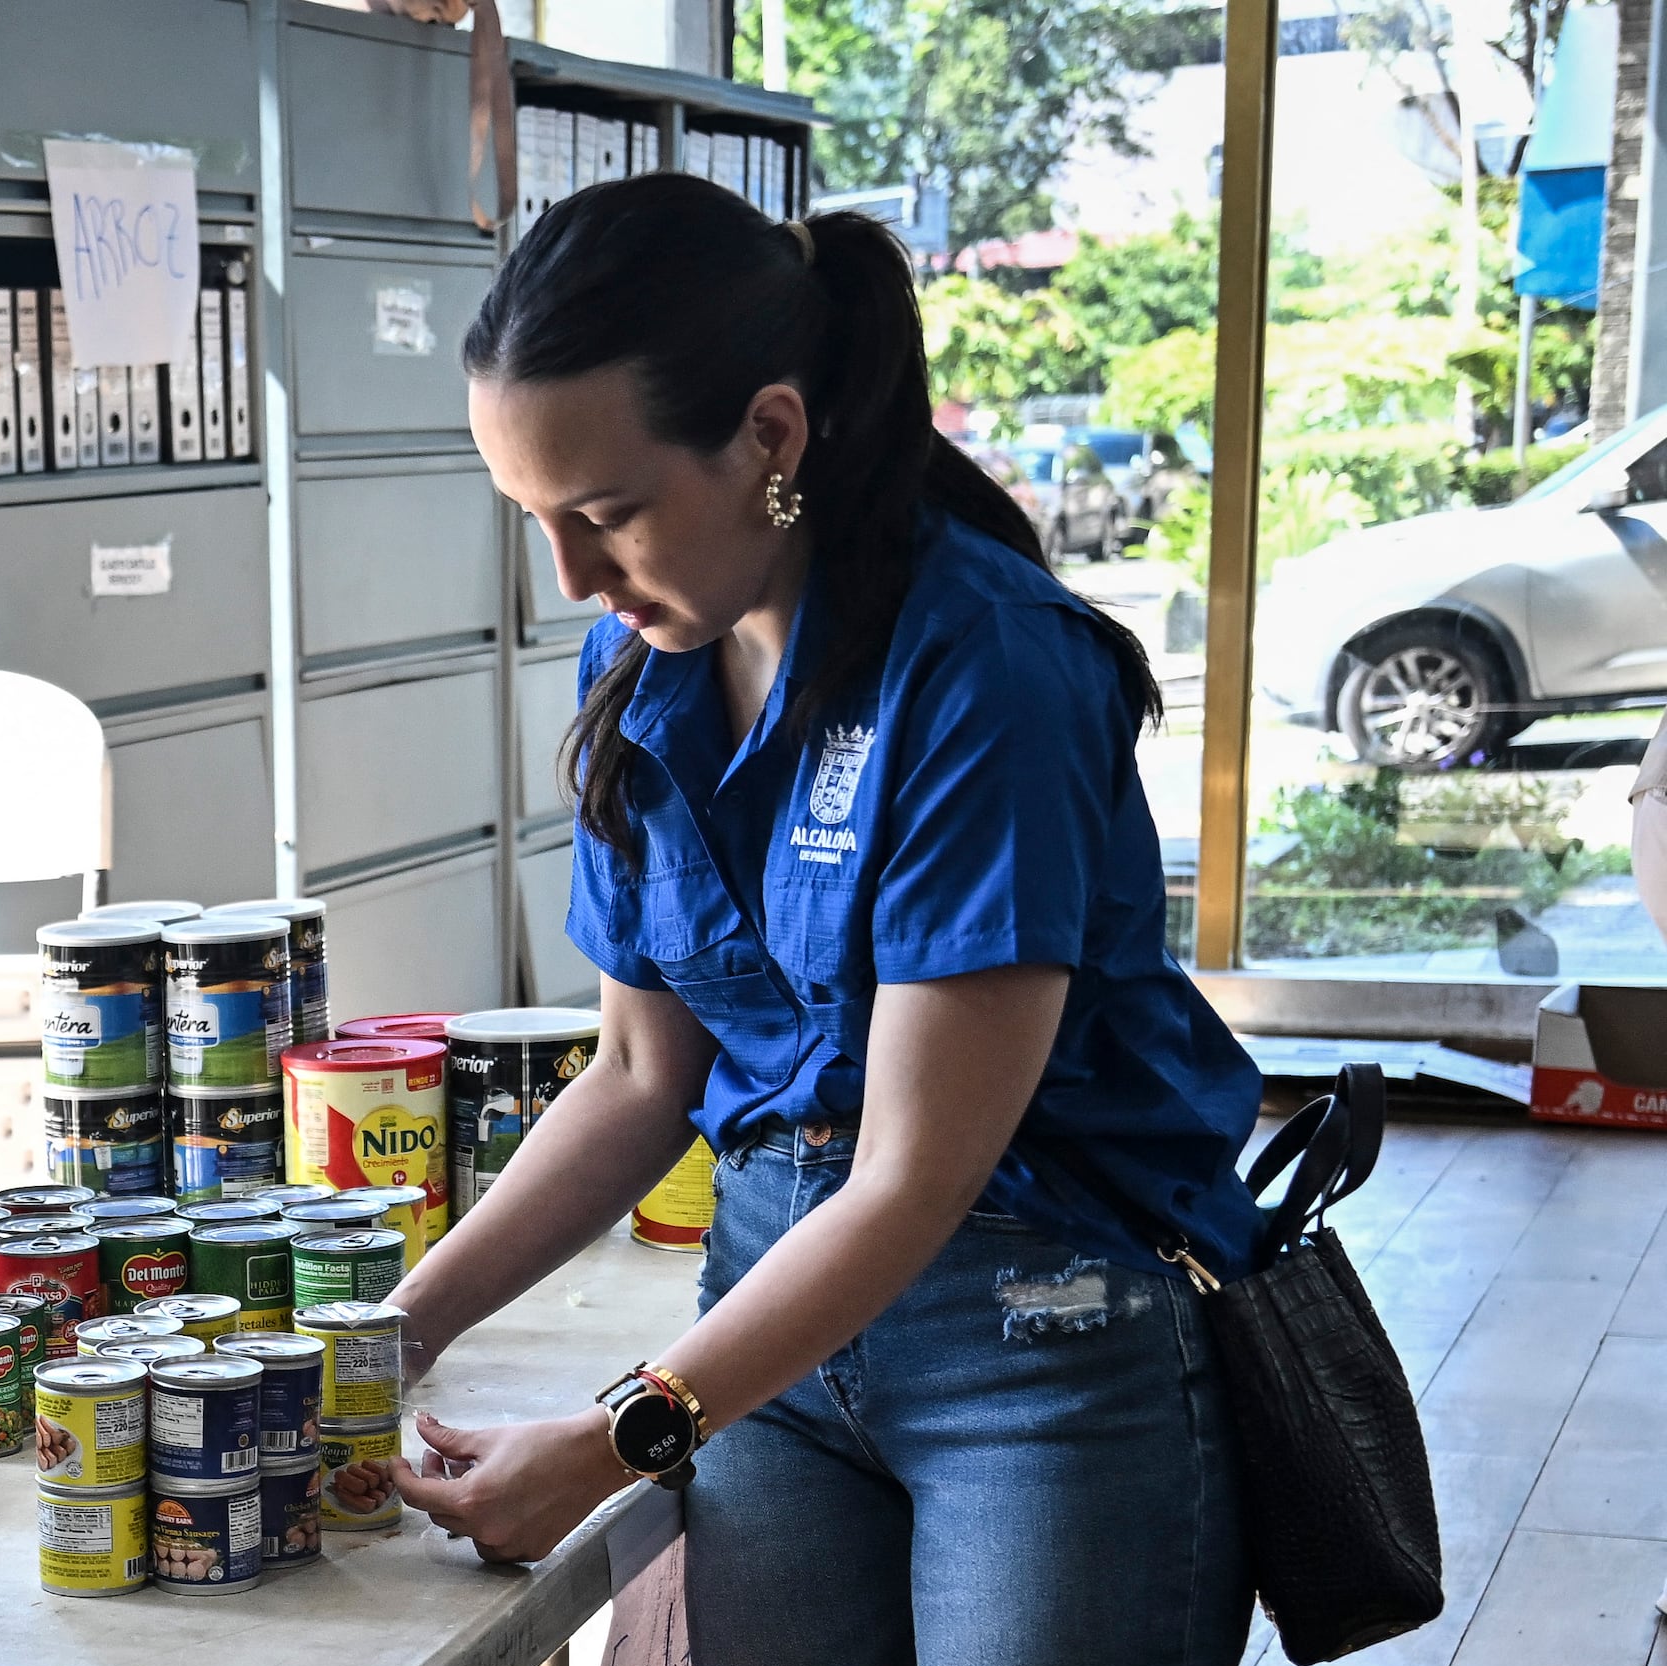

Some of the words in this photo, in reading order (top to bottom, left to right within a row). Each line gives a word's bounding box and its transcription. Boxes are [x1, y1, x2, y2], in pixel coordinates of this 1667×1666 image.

[73, 193, 185, 302] ARROZ
[790, 825, 856, 851] ALCALDÍA
[452, 1054, 495, 1074] perior
[225, 1107, 281, 1128] Superior
[362, 1125, 436, 1157] NIDO
[363, 1157, 409, 1169] Crecimiento
[127, 1266, 149, 1282] Del
[150, 1263, 186, 1281] Monte
[325, 1263, 351, 1273] Facts
[240, 1316, 276, 1333] getales
[352, 1359, 369, 1368] 220
[113, 1424, 128, 1433] 220
[183, 1528, 220, 1539] Sausages
